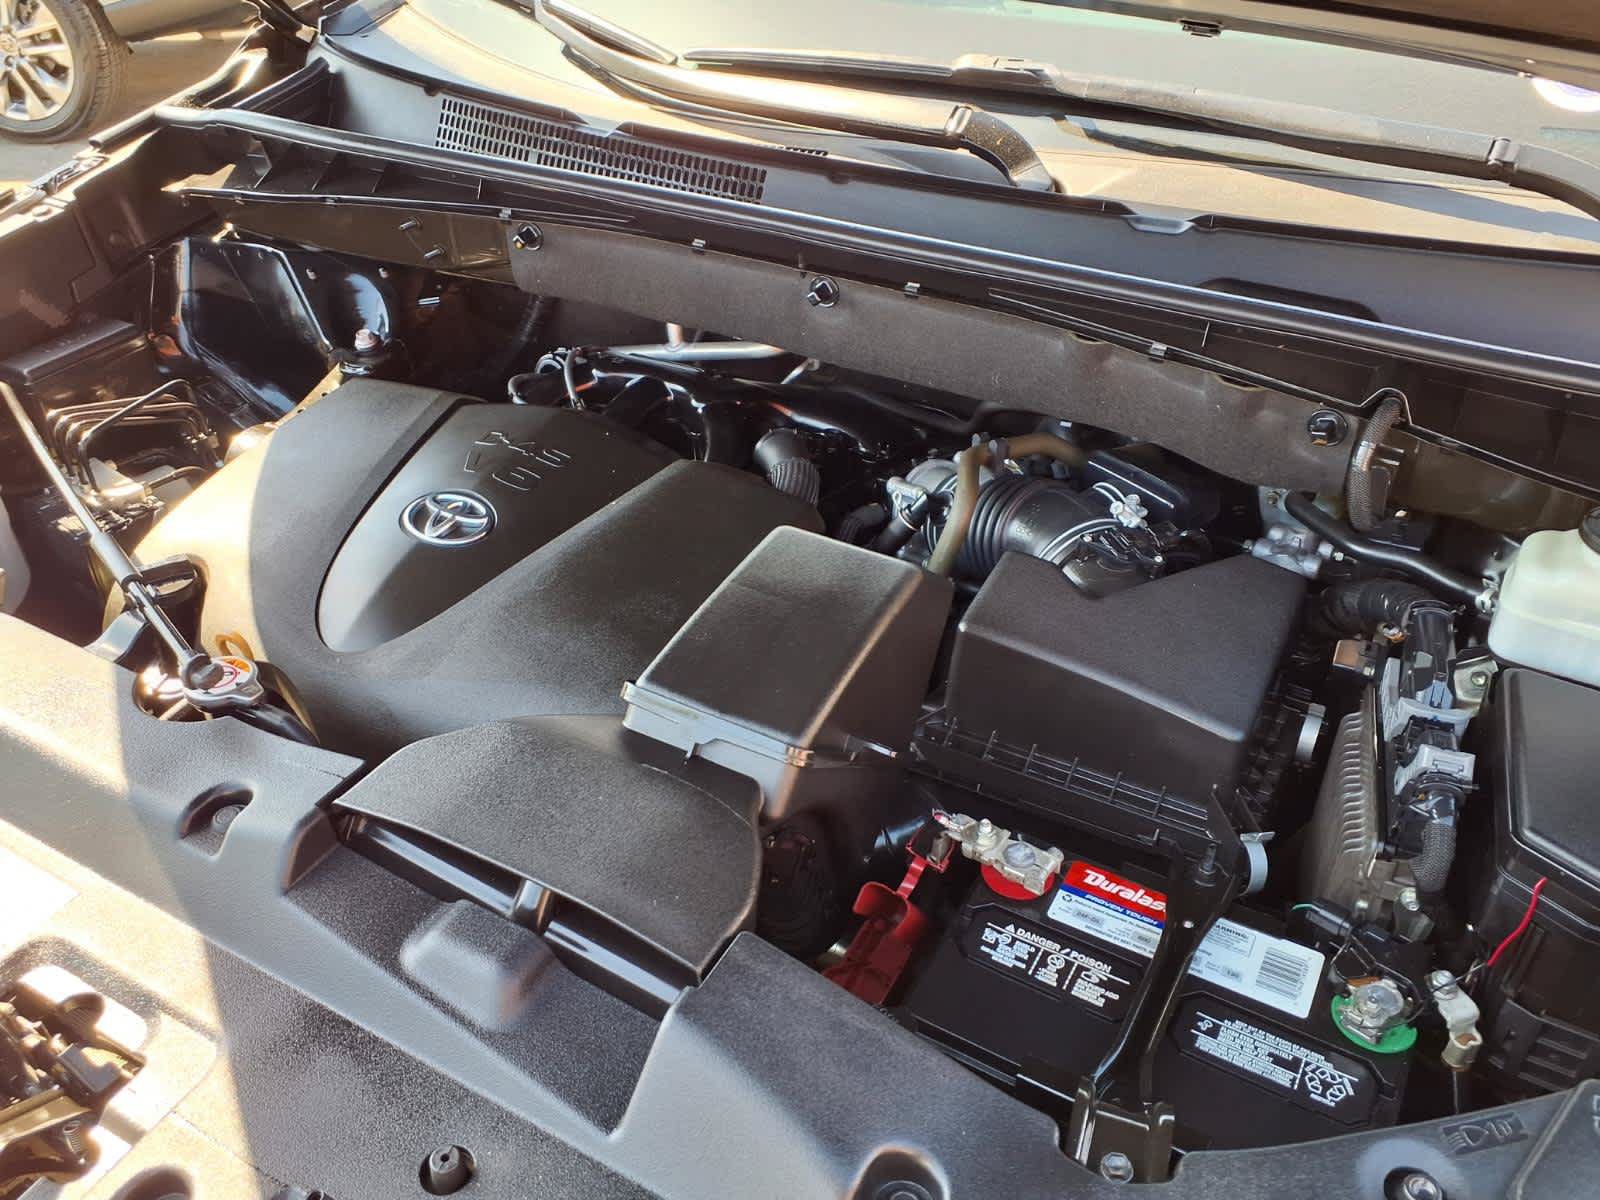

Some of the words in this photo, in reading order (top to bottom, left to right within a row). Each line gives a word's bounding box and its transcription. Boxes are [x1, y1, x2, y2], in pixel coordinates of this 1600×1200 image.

[1083, 869, 1167, 913] Duralas
[1085, 893, 1124, 913] PROVEN
[1125, 909, 1158, 926] TOUGH
[1016, 928, 1061, 951] DANGER
[1071, 950, 1112, 972] POISON
